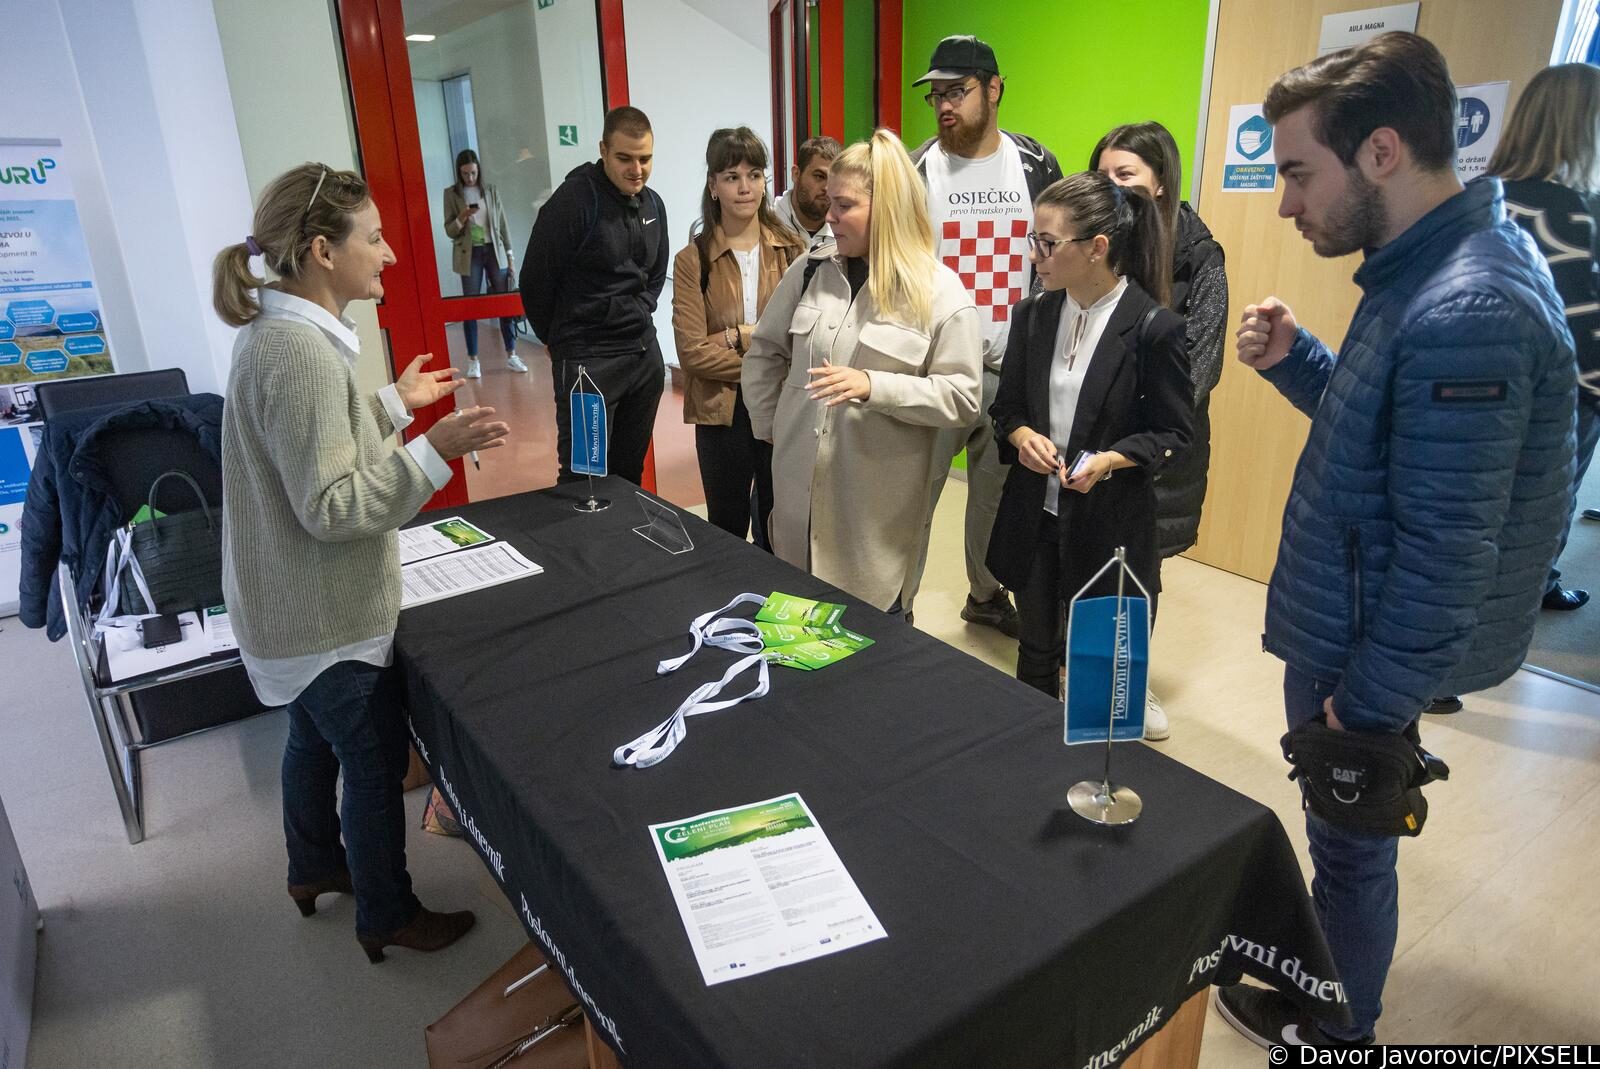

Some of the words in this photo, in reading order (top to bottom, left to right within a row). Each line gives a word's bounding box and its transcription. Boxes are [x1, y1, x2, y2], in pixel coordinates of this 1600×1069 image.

[1348, 24, 1363, 32] AULA
[1364, 21, 1385, 30] MAGNA
[948, 187, 1021, 205] OSJEČKO
[950, 208, 968, 217] prvo
[970, 206, 1003, 215] hrvatsko
[1005, 206, 1022, 215] pivo
[591, 401, 599, 432] dnevnik
[591, 433, 599, 463] Poslovni
[1111, 669, 1127, 720] Poslovni
[1332, 767, 1357, 784] CAT
[677, 827, 706, 838] ZELENI
[709, 820, 730, 830] PLAN
[1187, 934, 1277, 984] Posvni
[1082, 1005, 1164, 1069] dnevnik
